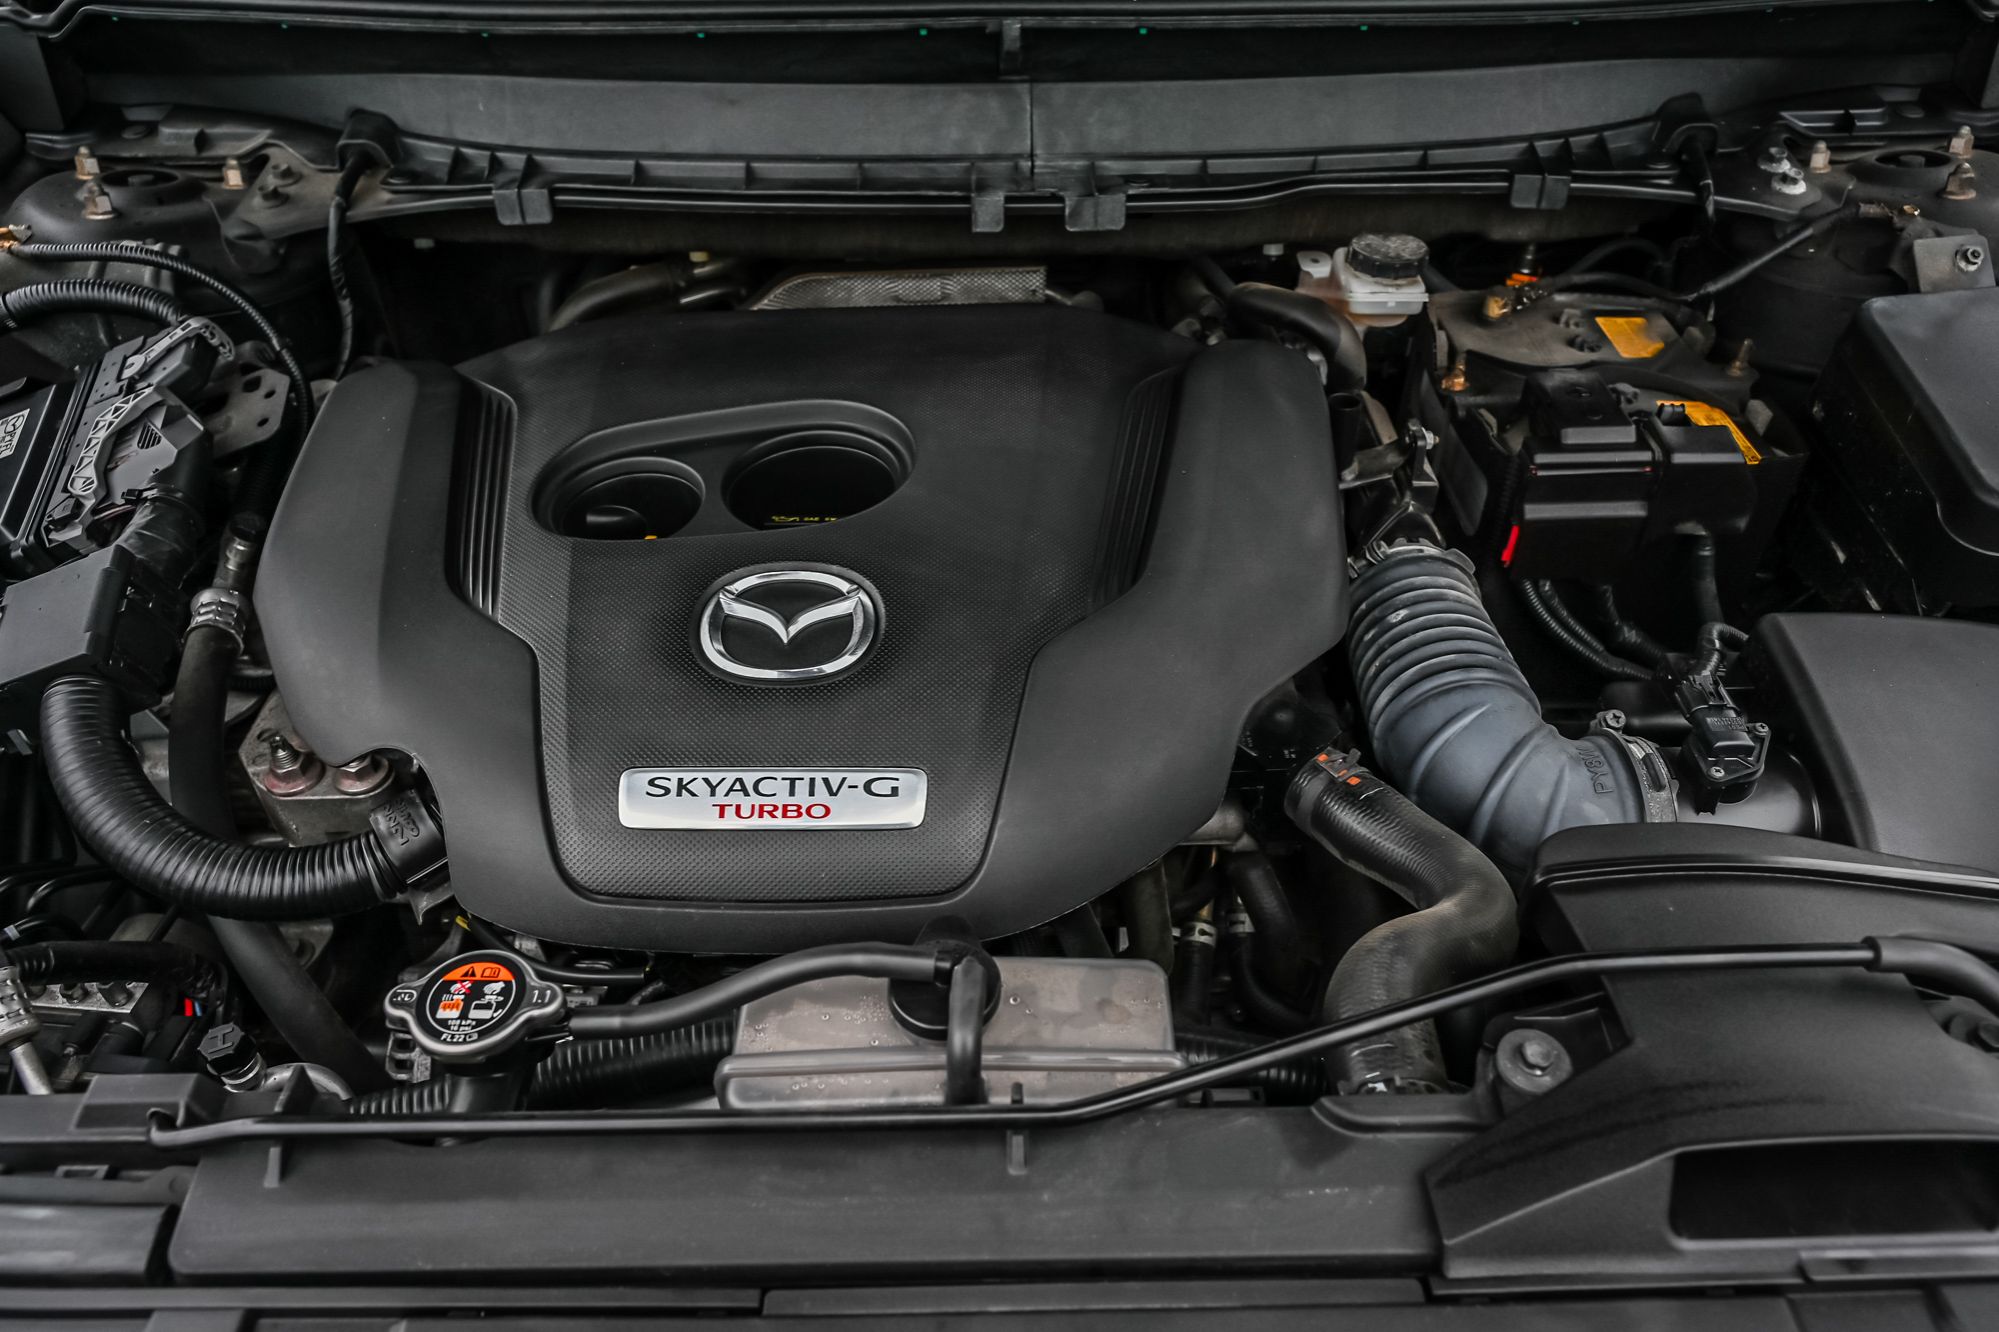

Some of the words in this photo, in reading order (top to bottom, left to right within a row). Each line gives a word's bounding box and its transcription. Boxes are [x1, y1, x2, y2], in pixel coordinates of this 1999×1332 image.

[645, 776, 900, 798] SKYACTIV-G
[712, 803, 831, 819] TURBO
[532, 989, 551, 1003] 1.1
[440, 1033, 465, 1042] FL22
